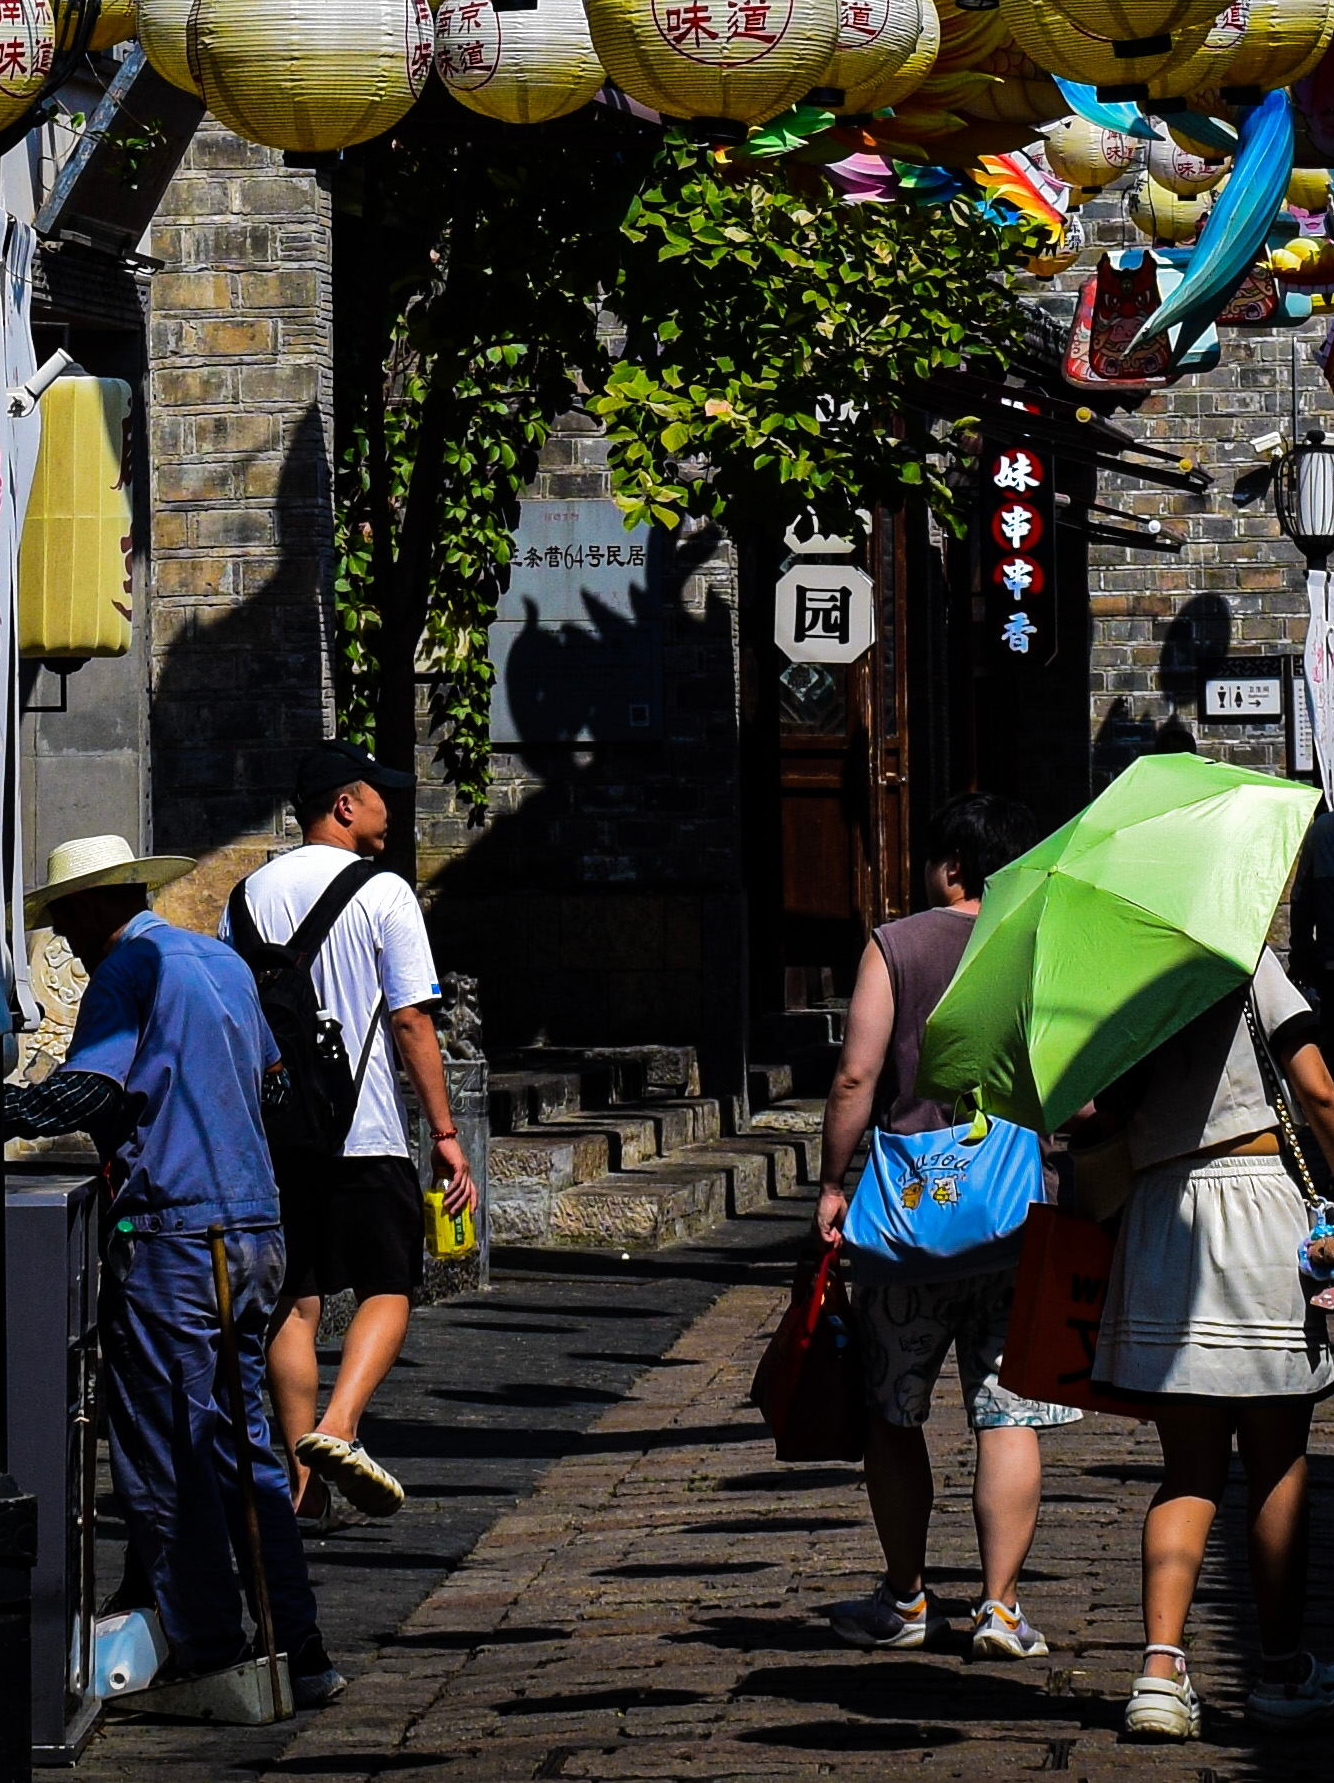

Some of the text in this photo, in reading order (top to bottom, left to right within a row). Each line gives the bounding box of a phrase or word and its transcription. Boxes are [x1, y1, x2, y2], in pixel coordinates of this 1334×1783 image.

[438, 0, 491, 36] 南京
[666, 1, 777, 47] 味道
[840, 0, 877, 36] 道
[437, 41, 492, 78] 味道
[993, 406, 1041, 654] 妹串串香
[510, 544, 646, 570] 三条营64号民居
[794, 585, 854, 644] 园
